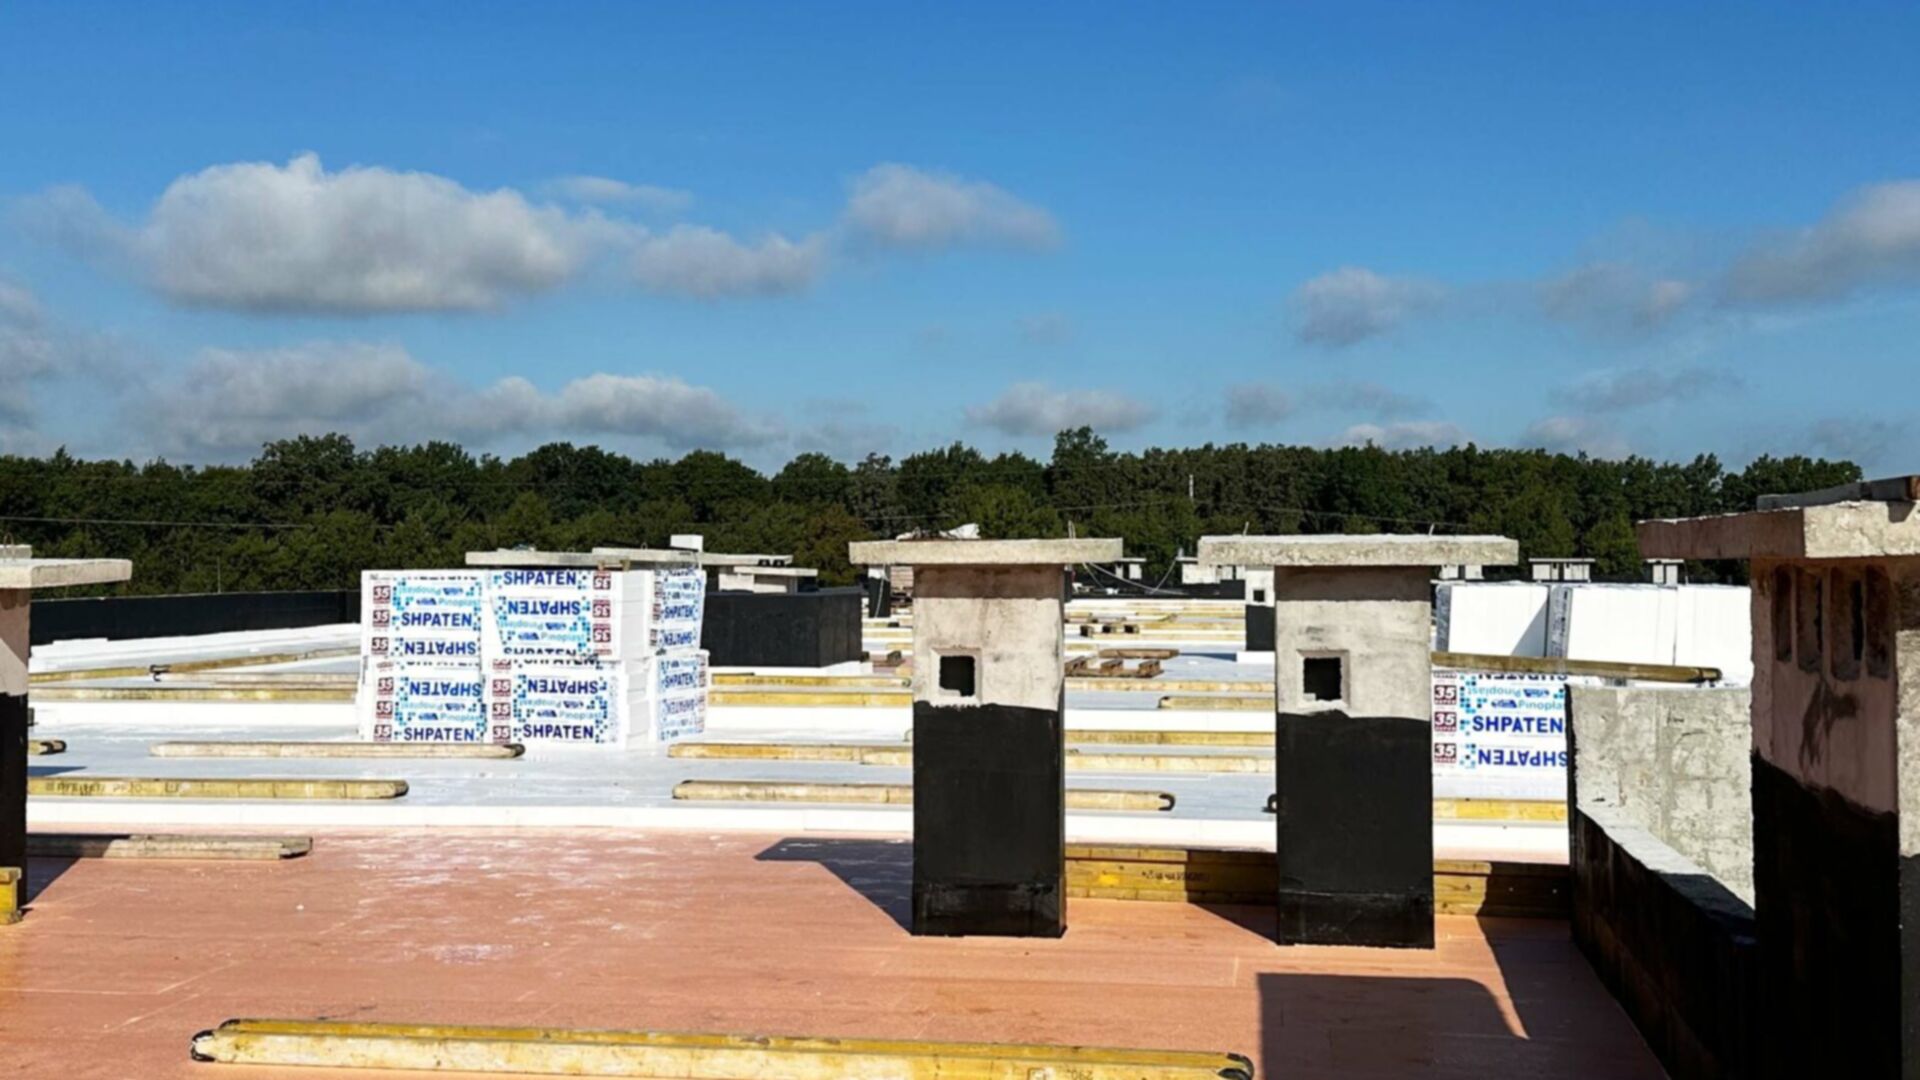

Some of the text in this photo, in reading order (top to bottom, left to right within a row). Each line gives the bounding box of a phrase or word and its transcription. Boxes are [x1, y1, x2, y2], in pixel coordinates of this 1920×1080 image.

[503, 571, 577, 585] SHPATEN
[374, 586, 390, 599] 35
[507, 600, 581, 615] SHPATEN
[373, 611, 390, 622] 35
[401, 612, 472, 627] SHPATEN
[372, 639, 388, 650] 35
[404, 641, 476, 655] SHPATEN
[409, 681, 481, 696] SHPATEN
[527, 679, 599, 694] SHPATEN
[1434, 687, 1455, 699] 35
[1434, 713, 1455, 726] 35
[1472, 716, 1563, 733] SHPATEN
[404, 727, 475, 741] SHPATEN
[523, 724, 594, 739] SHPATEN
[1434, 744, 1455, 757] 35
[1478, 749, 1568, 767] SHPATEN
